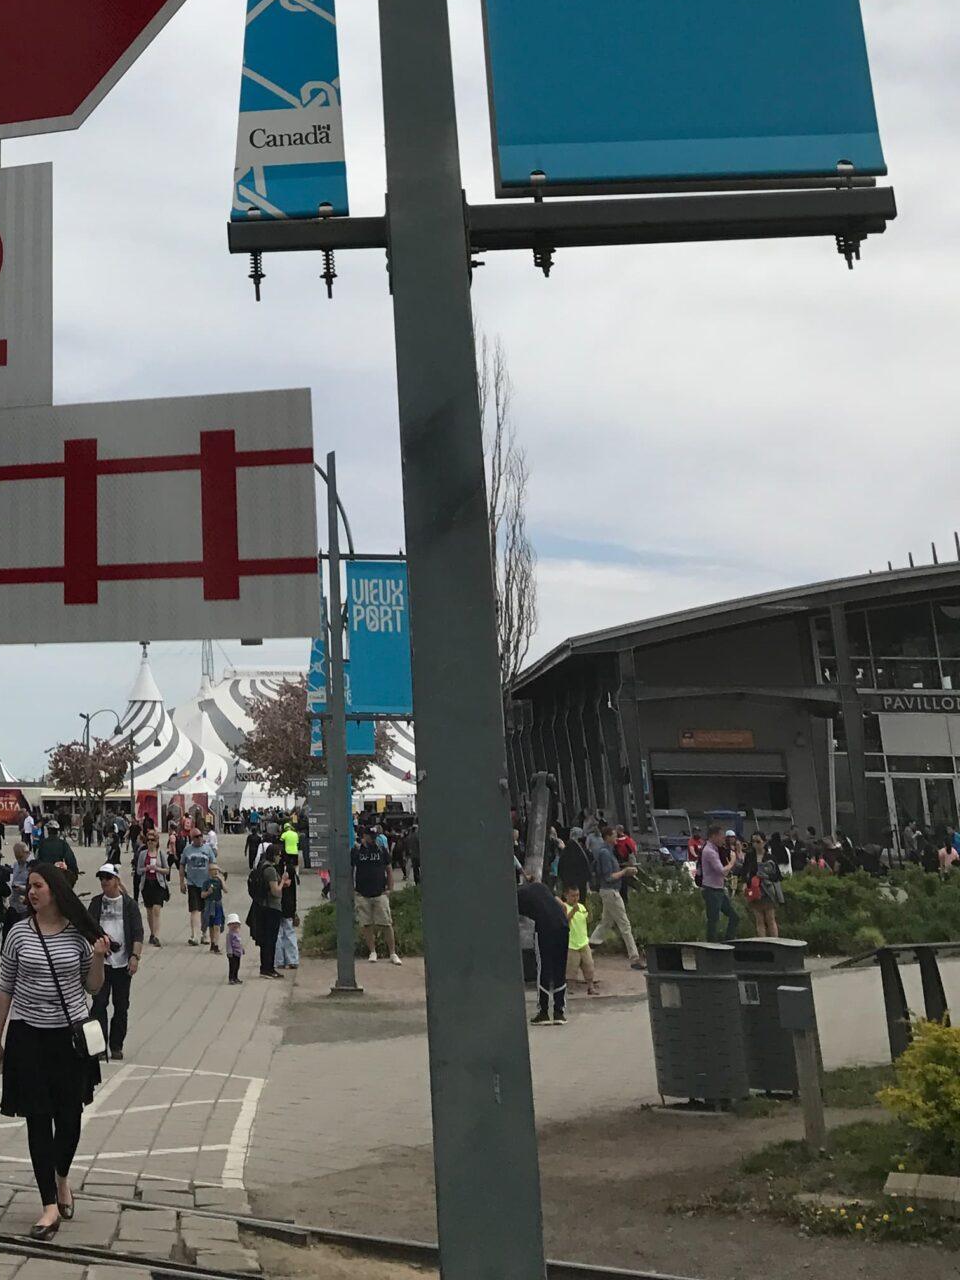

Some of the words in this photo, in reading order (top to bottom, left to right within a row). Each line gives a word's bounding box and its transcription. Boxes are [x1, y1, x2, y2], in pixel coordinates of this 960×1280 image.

[249, 123, 332, 149] Canada
[351, 578, 405, 607] VIEUX
[352, 604, 405, 633] PORT
